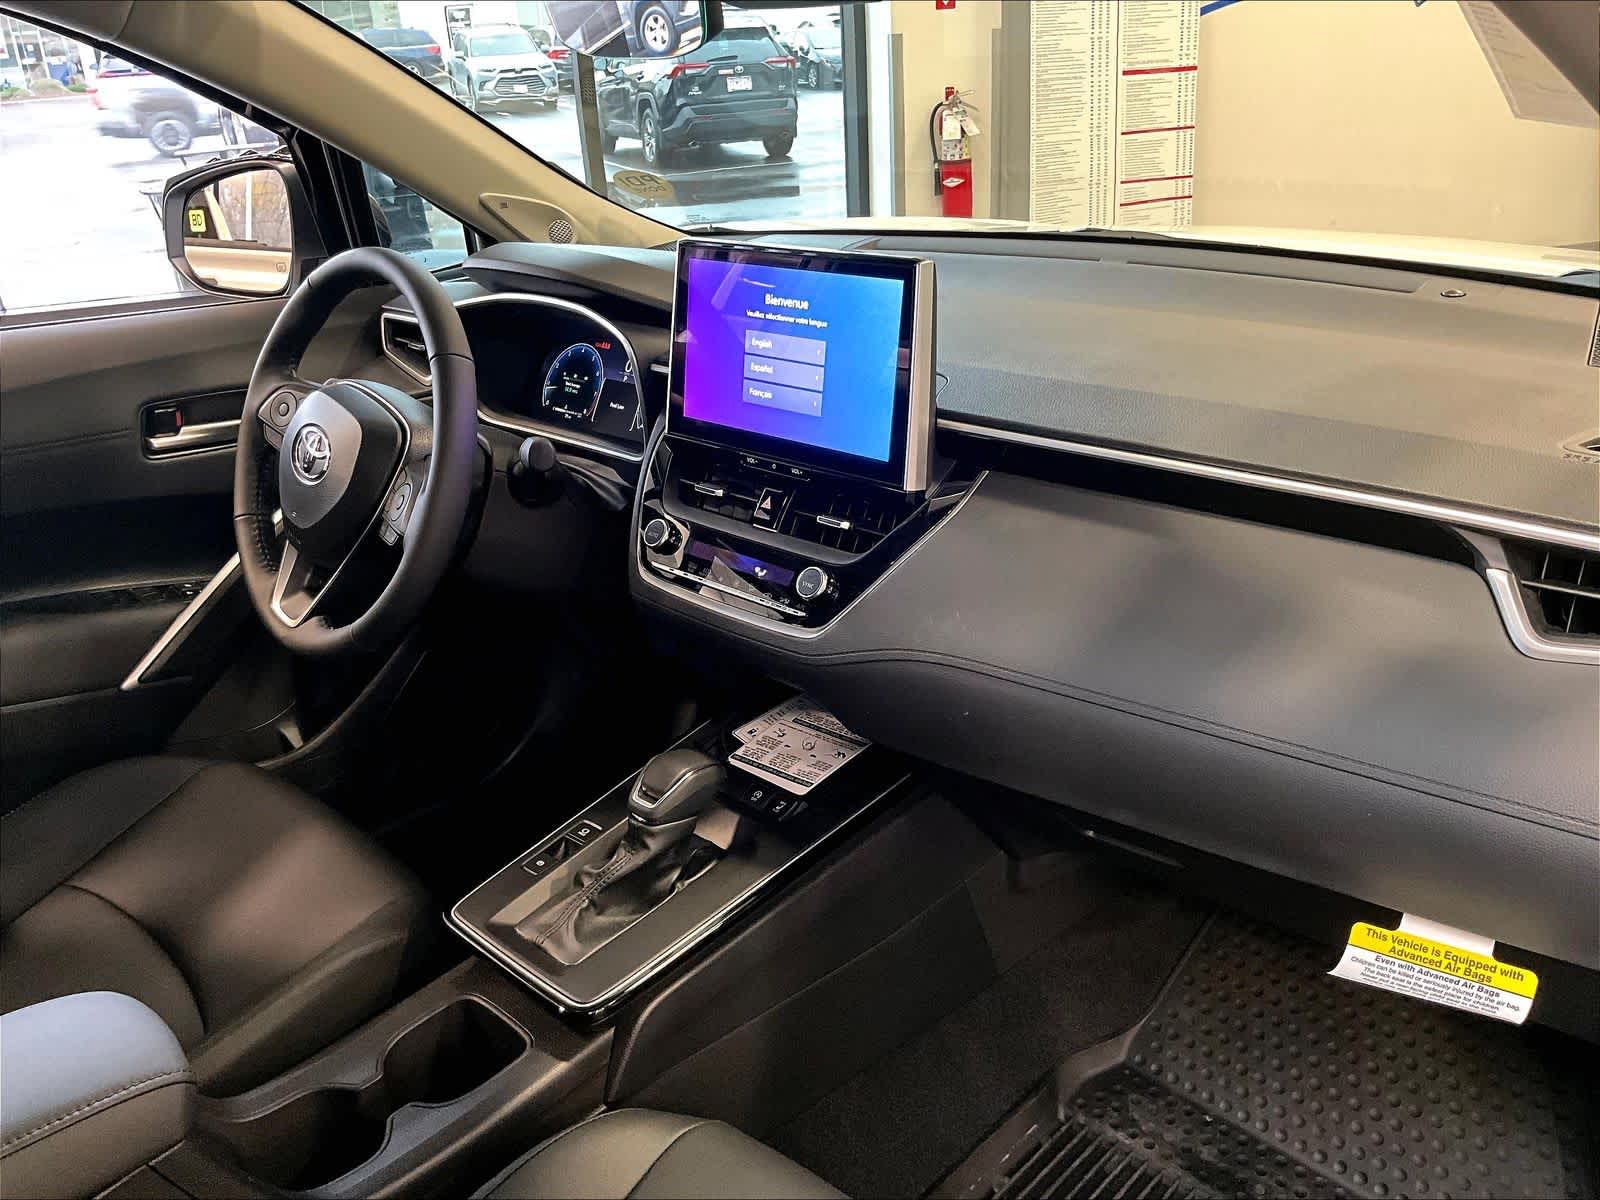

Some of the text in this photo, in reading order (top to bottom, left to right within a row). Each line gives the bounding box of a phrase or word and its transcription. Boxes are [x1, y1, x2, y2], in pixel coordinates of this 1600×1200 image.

[764, 293, 809, 311] Bienvenue
[809, 318, 828, 329] langue
[751, 337, 773, 350] English
[750, 361, 774, 375] Español
[749, 386, 773, 400] Français
[1366, 928, 1525, 982] This Vehicle is Equipped with
[1388, 945, 1493, 984] Advanced Air Bags
[1350, 956, 1376, 968] Children
[1376, 964, 1388, 972] can
[1388, 967, 1397, 975] be
[1451, 986, 1474, 998] injured
[1475, 992, 1483, 1000] by
[1484, 996, 1495, 1004] the
[1375, 954, 1500, 998] Even with Advanced Air Bags
